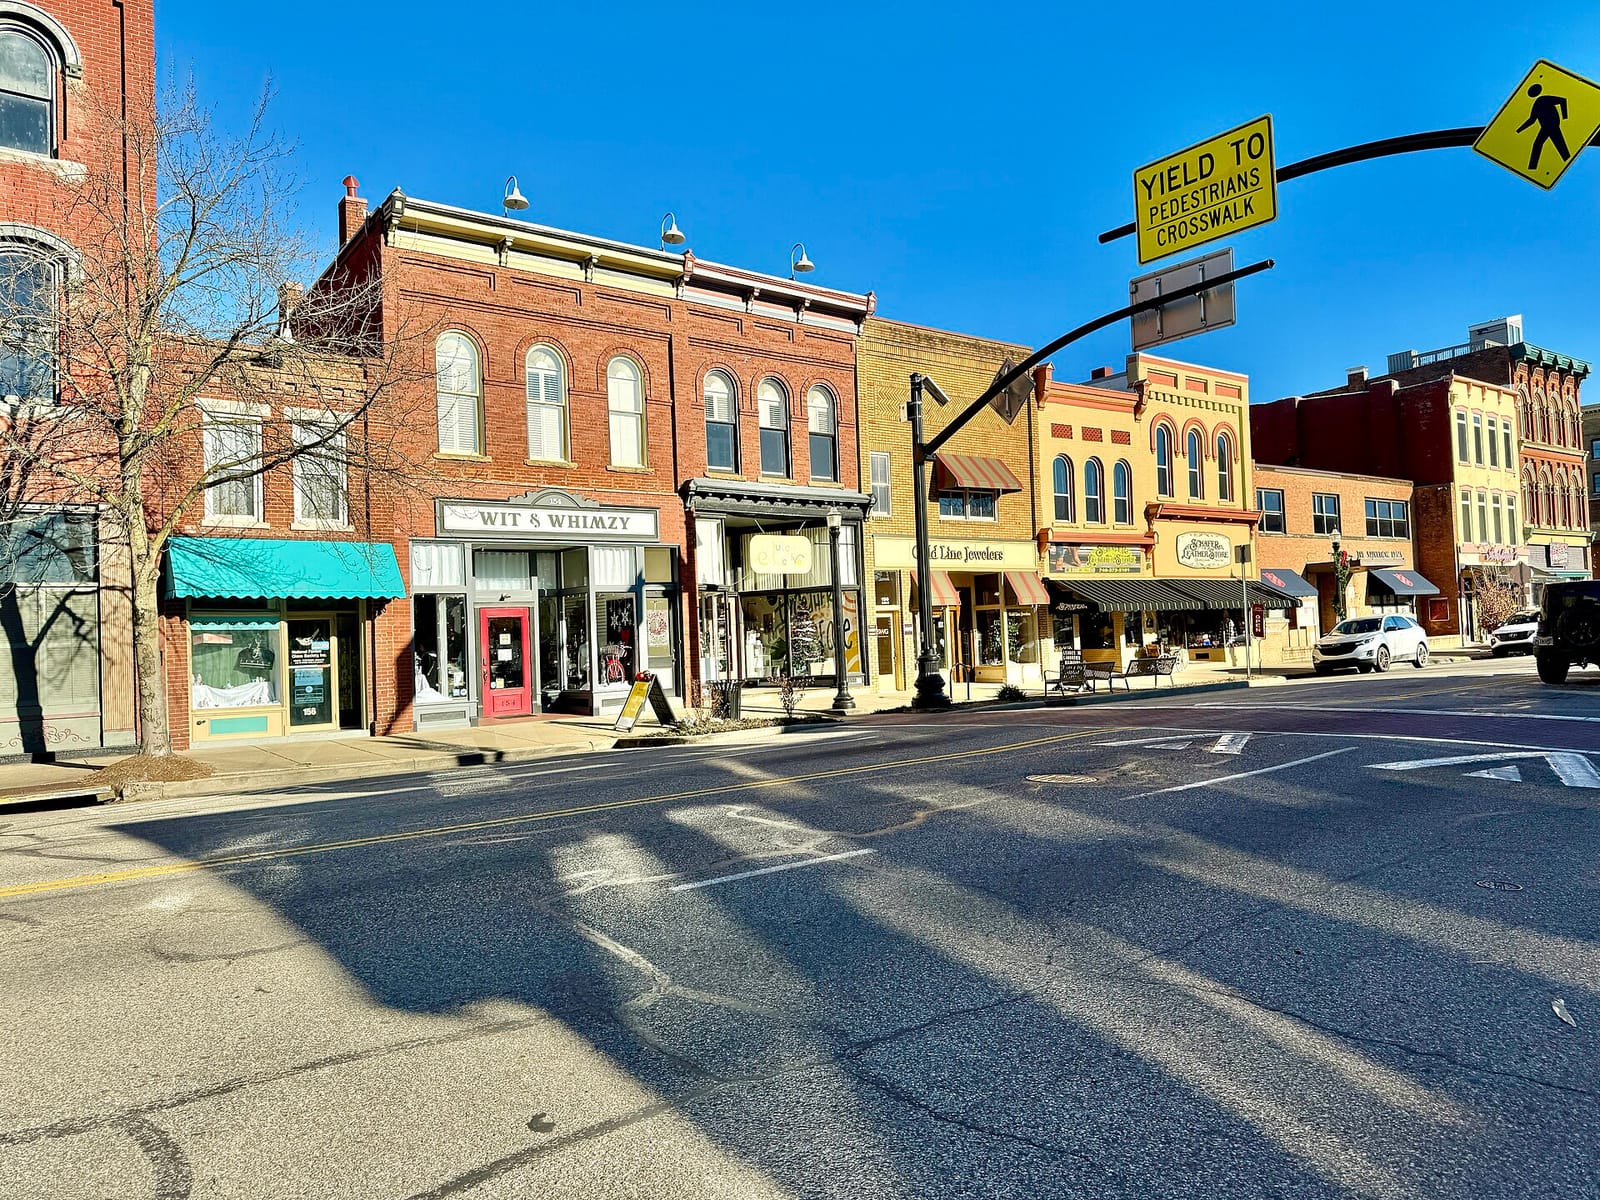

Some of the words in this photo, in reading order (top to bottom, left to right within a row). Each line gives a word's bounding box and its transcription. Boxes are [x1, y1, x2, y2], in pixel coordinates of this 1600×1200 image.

[1141, 153, 1215, 200] YIELD
[1230, 132, 1265, 166] TO
[1150, 167, 1260, 224] PEDESTRIANS
[1157, 196, 1254, 246] CROSSWALK
[479, 511, 521, 527] WIT
[547, 514, 631, 530] WHIMZY
[939, 545, 962, 560] Line
[963, 546, 1004, 563] Jewelers
[1182, 545, 1209, 559] LEATHER
